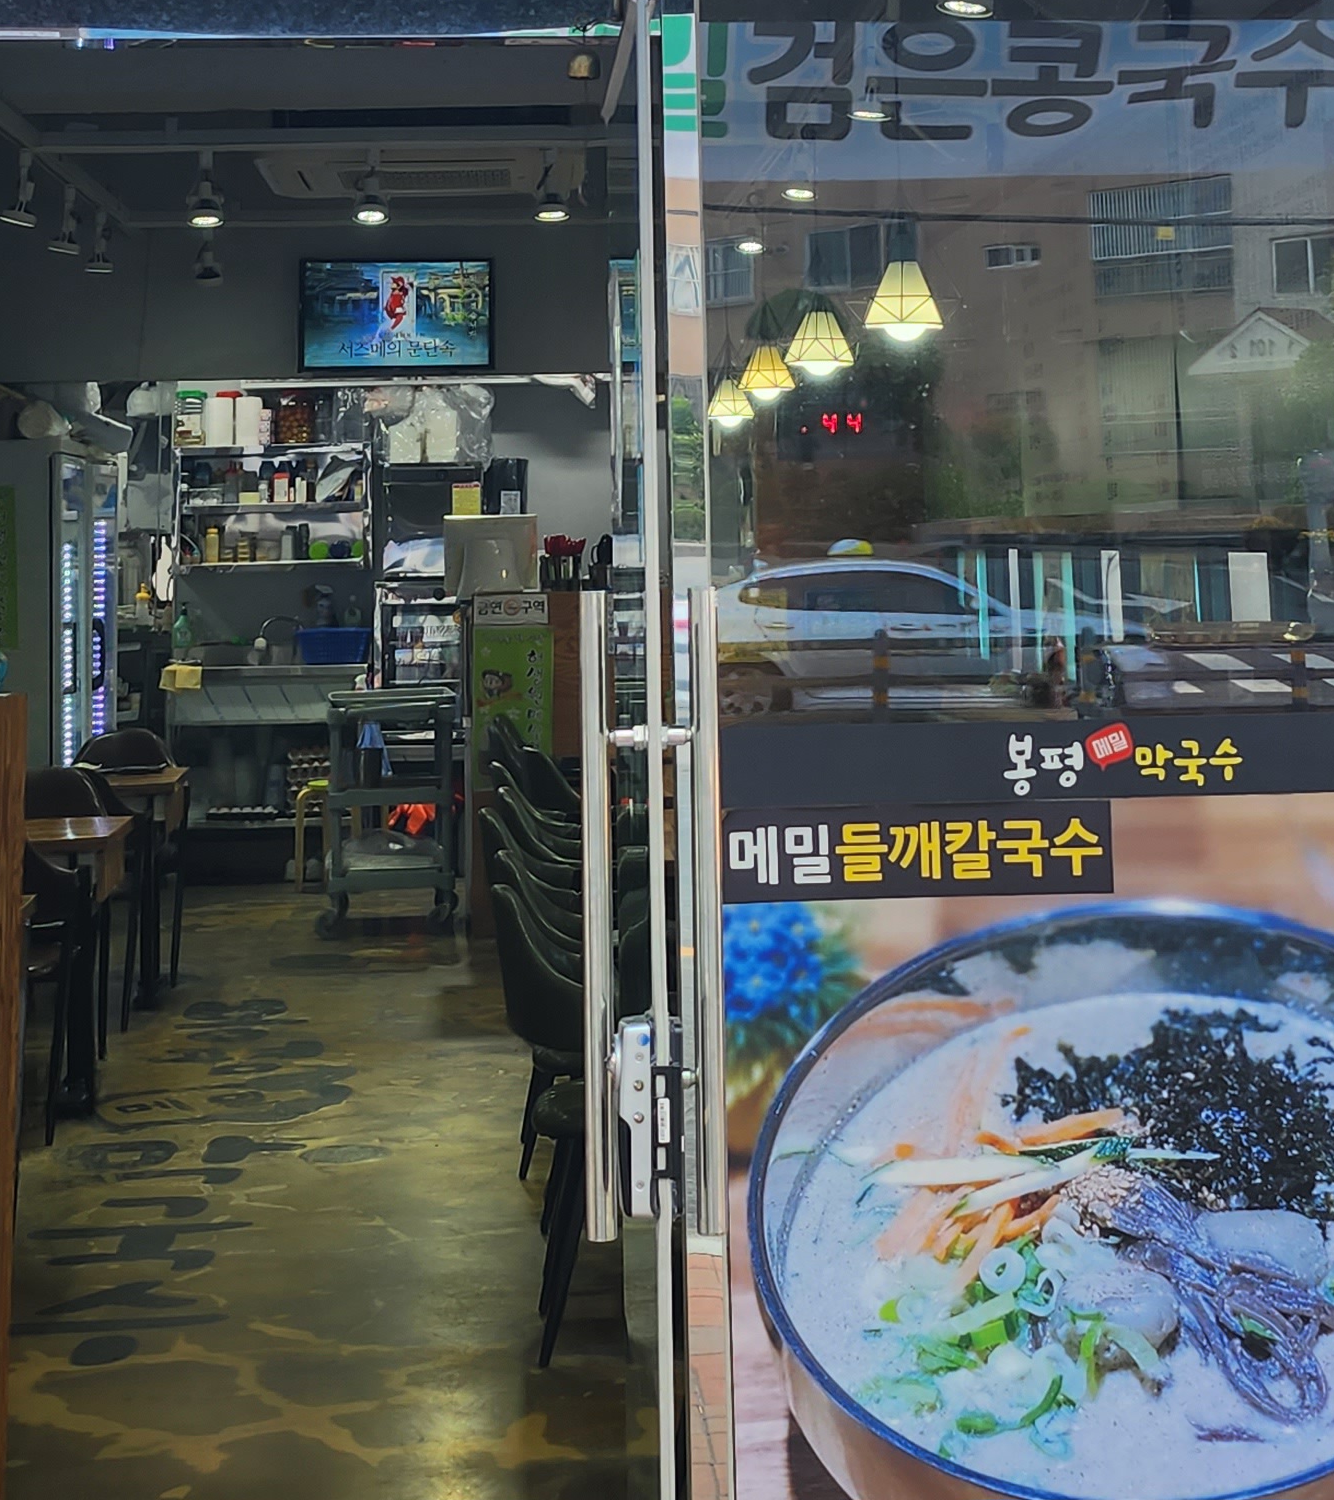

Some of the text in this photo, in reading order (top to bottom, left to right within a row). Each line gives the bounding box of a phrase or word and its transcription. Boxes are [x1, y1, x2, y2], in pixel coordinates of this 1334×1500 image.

[476, 599, 546, 616] 금연 구역
[1002, 730, 1244, 796] 봉평 메밀 막국수
[727, 816, 1105, 886] 메밀들깨칼국수
